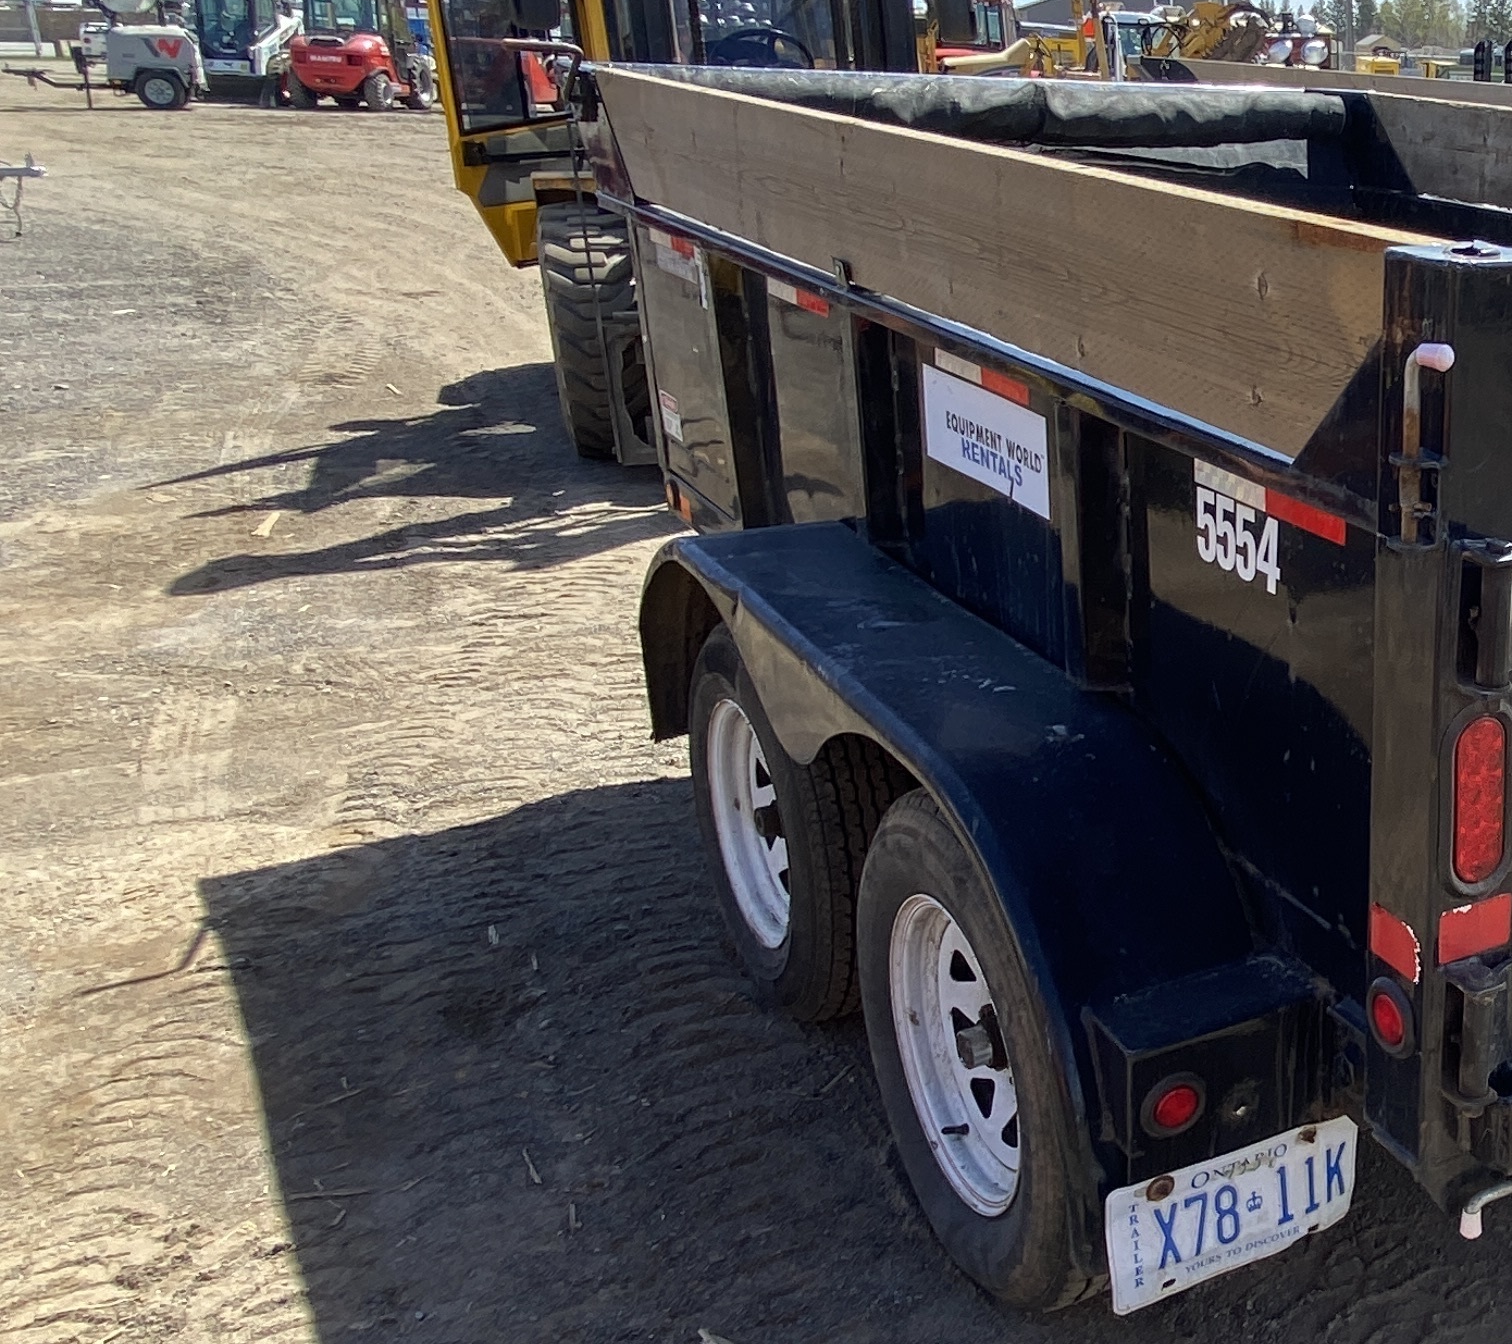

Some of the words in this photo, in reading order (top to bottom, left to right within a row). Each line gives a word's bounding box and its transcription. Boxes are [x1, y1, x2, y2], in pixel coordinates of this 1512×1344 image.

[945, 410, 1002, 453] EQUIPMENT
[1005, 438, 1043, 474] WORLD
[961, 437, 1023, 487] RENTALS
[1196, 486, 1280, 595] 5554
[1191, 1143, 1288, 1189] ONTARIO
[1153, 1184, 1241, 1270] X78
[1277, 1141, 1347, 1226] 11K
[1128, 1204, 1145, 1289] TRAILER
[1185, 1254, 1222, 1274] YOURS
[1226, 1247, 1242, 1260] TO
[1245, 1225, 1300, 1255] DISCOVER
